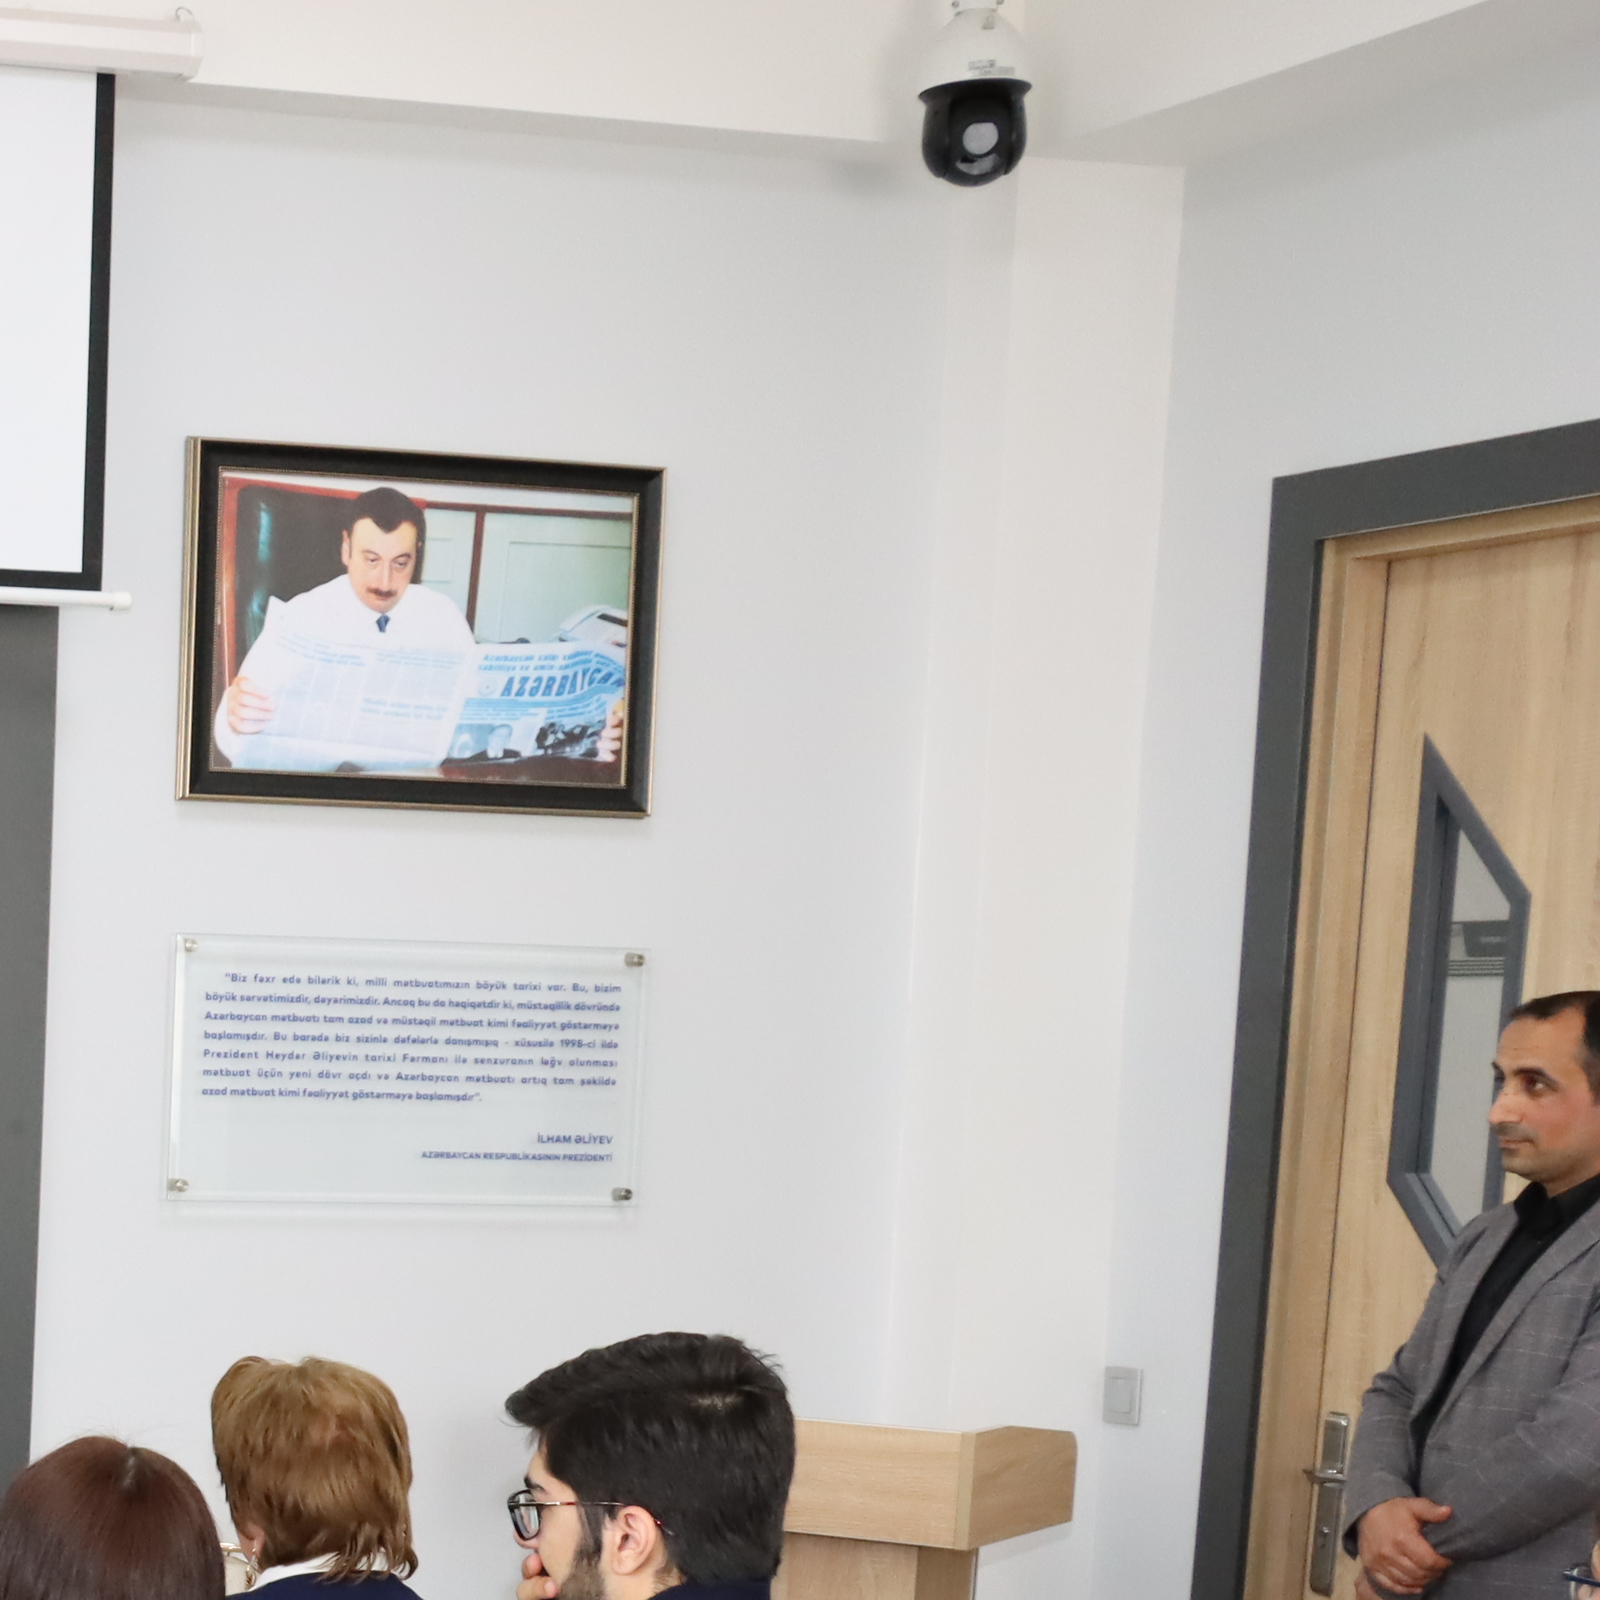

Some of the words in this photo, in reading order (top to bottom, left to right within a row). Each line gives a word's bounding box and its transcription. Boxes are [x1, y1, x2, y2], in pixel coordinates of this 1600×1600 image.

[253, 973, 276, 983] fəxr
[281, 975, 301, 984] edə
[306, 975, 340, 985] bilərik
[364, 977, 387, 986] milli
[392, 979, 470, 989] mətbuatımızın
[475, 980, 507, 991] böyük
[512, 981, 541, 990] tarixi
[593, 983, 621, 993] bizim
[205, 991, 237, 1003] böyük
[382, 996, 416, 1008] Ancaq
[417, 997, 430, 1007] bu
[432, 998, 446, 1007] da
[447, 998, 500, 1010] həqiqətdir
[572, 1002, 620, 1011] dövründə
[204, 1011, 268, 1022] Azərbaycan
[270, 1013, 320, 1022] mətbuatı
[322, 1015, 344, 1023] tam
[347, 1015, 373, 1024] azad
[376, 1017, 388, 1025] və
[391, 1016, 436, 1027] müstəqil
[438, 1017, 484, 1027] mətbuat
[486, 1018, 508, 1027] kimi
[510, 1018, 558, 1030] fəaliyyət
[559, 1020, 619, 1032] göstərməyə
[273, 1031, 287, 1041] Bu
[292, 1032, 329, 1042] barədə
[334, 1033, 350, 1043] biz
[355, 1034, 388, 1043] sizinlə
[393, 1034, 439, 1044] dəfələrlə
[444, 1036, 498, 1048] danışmışıq
[513, 1037, 554, 1047] xüsusilə
[559, 1038, 596, 1048] 1998-ci
[600, 1039, 618, 1049] ildə
[202, 1048, 258, 1059] Prezident
[265, 1050, 306, 1061] Heydər
[312, 1051, 358, 1062] Əliyevin
[364, 1053, 396, 1062] tarixi
[402, 1053, 448, 1063] Fərmanı
[454, 1054, 468, 1064] ilə
[473, 1057, 534, 1065] senzuranın
[540, 1056, 562, 1068] ləğv
[568, 1057, 618, 1067] olunması
[202, 1068, 250, 1077] mətbuat
[256, 1068, 283, 1079] üçün
[288, 1069, 311, 1080] yeni
[316, 1069, 342, 1079] dövr
[348, 1070, 371, 1081] açdı
[394, 1071, 459, 1083] Azərbaycan
[464, 1074, 515, 1083] mətbuatı
[520, 1076, 547, 1086] artıq
[552, 1077, 574, 1085] tam
[579, 1076, 616, 1086] şəkildə
[201, 1086, 227, 1095] azad
[229, 1087, 276, 1096] mətbuat
[278, 1087, 300, 1097] kimi
[302, 1088, 349, 1100] fəaliyyət
[351, 1089, 413, 1101] göstərməyə
[536, 1134, 572, 1143] İLHAM
[573, 1133, 612, 1144] ƏLİYEV
[421, 1150, 481, 1159] AZƏRBAYCAN
